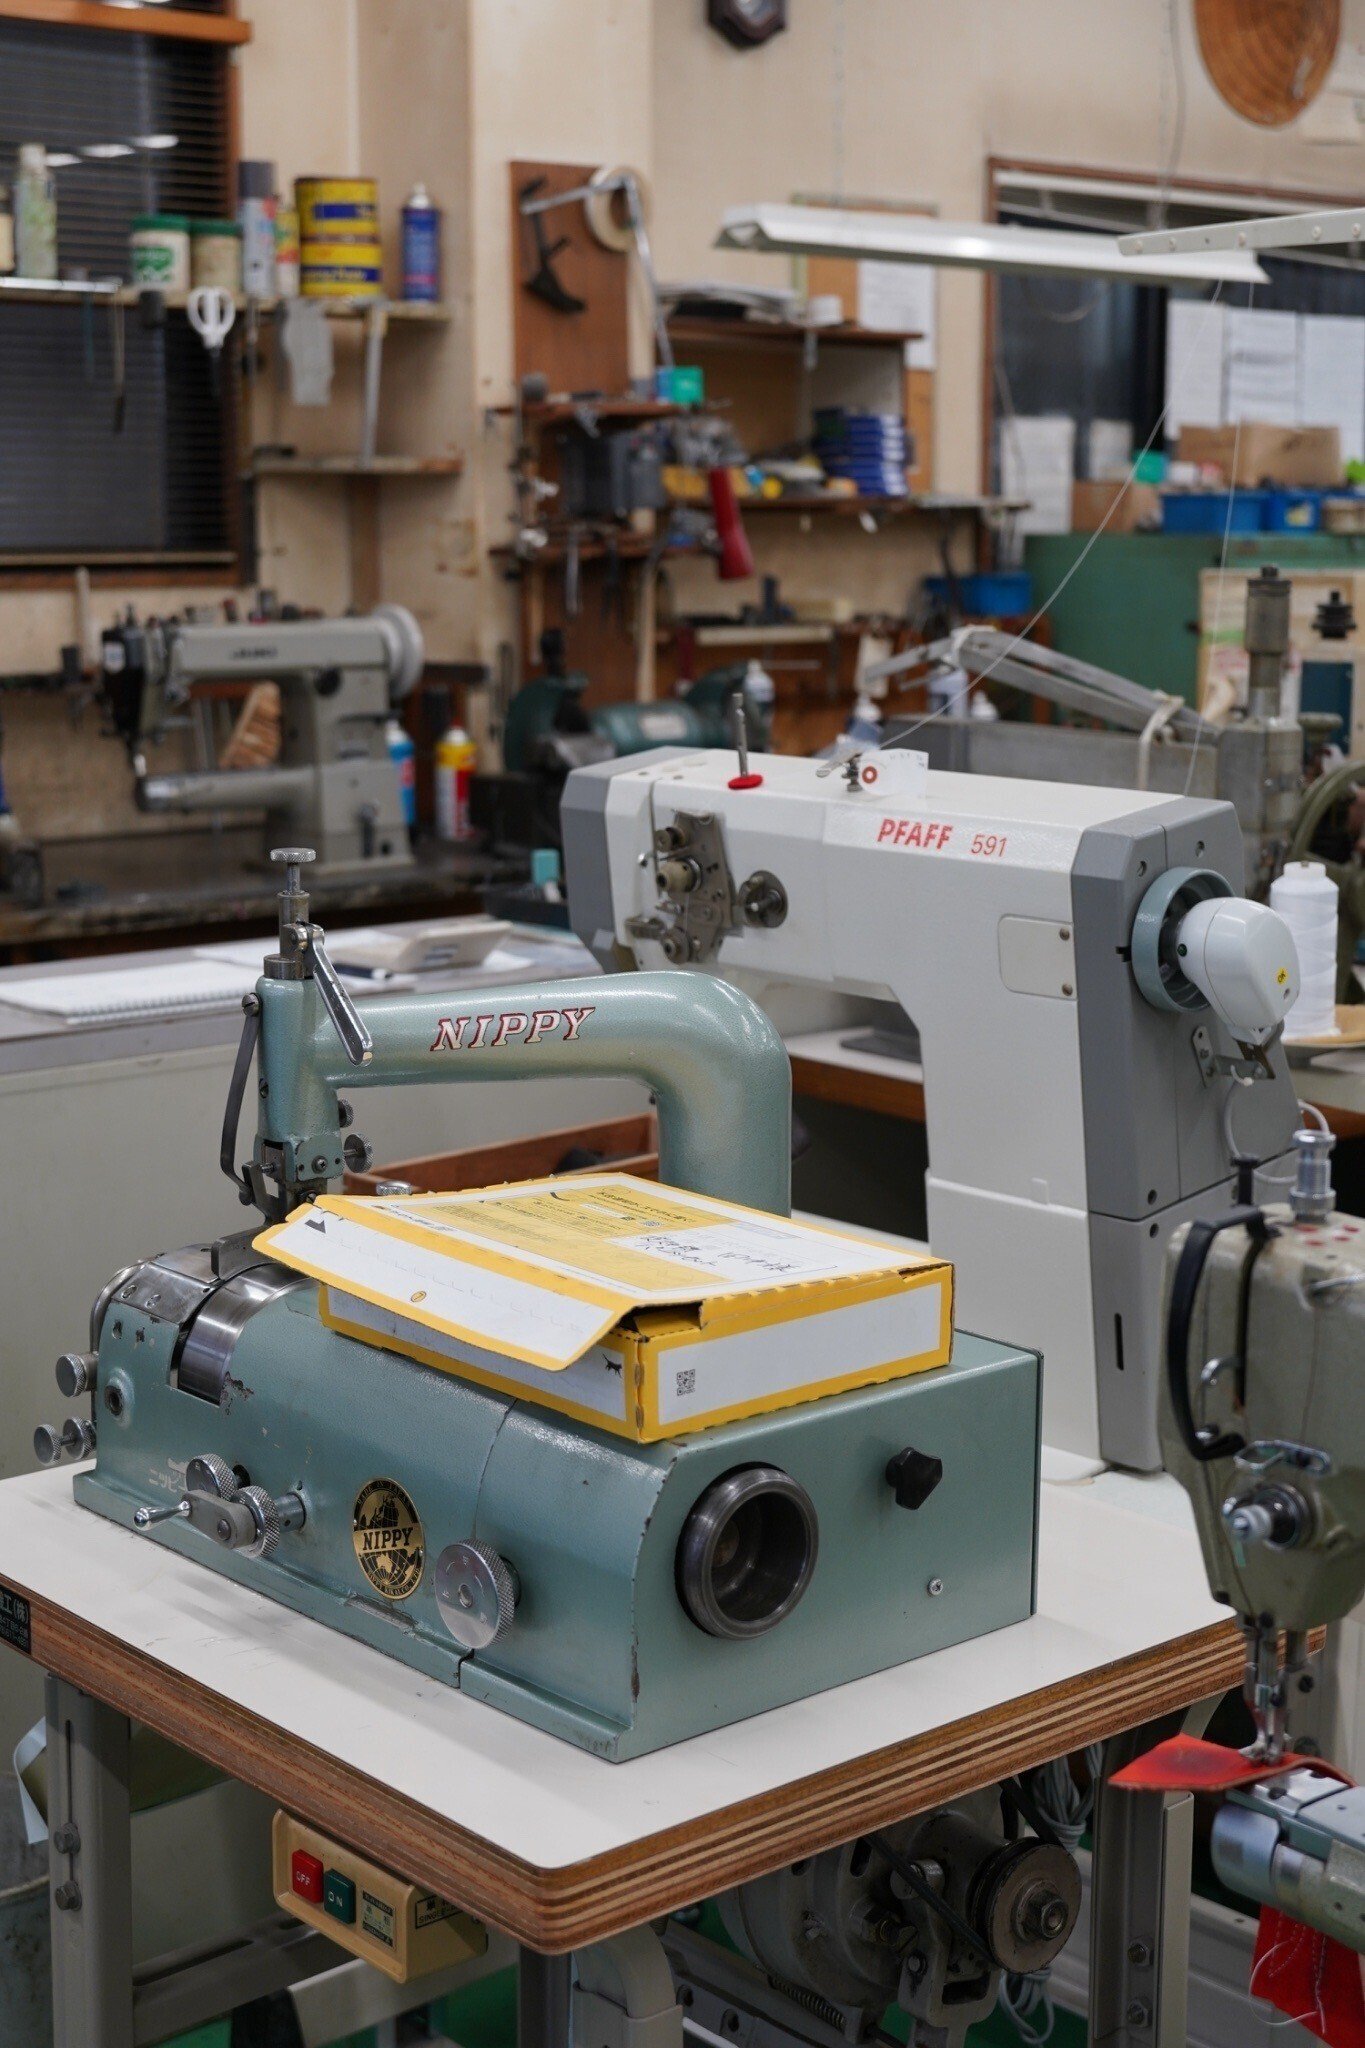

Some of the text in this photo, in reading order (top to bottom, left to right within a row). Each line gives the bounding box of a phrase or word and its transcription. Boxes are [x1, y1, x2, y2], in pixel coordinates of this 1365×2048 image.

[877, 818, 1008, 857] PFAFF 591
[430, 1006, 596, 1051] NIPPY
[363, 1527, 414, 1550] NIPPY
[296, 1870, 311, 1886] OFF
[328, 1890, 343, 1908] ON
